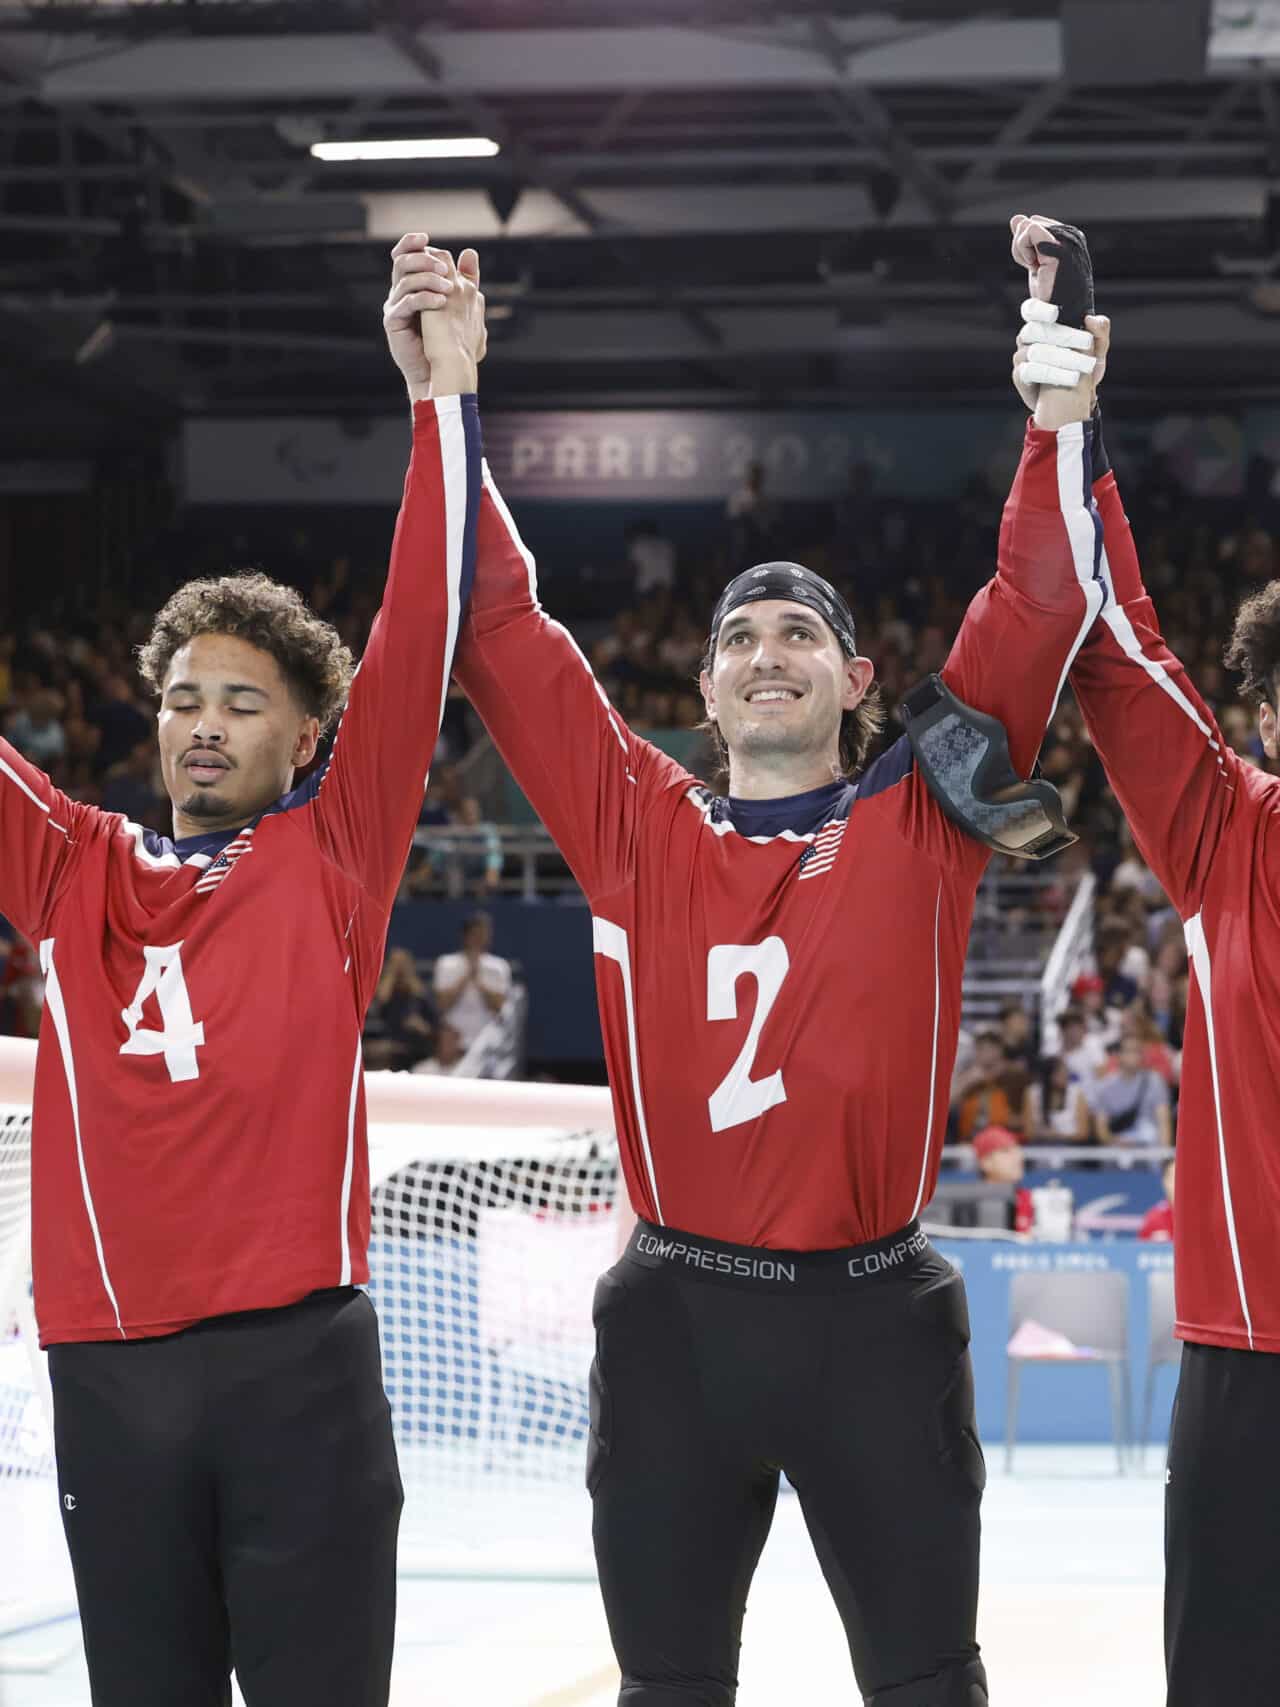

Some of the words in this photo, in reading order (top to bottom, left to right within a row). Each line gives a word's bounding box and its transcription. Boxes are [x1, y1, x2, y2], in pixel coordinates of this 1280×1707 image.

[512, 436, 699, 479] PARIS
[120, 941, 204, 1082] 4
[707, 936, 789, 1132] 2
[637, 1233, 795, 1282] COMPRESSION
